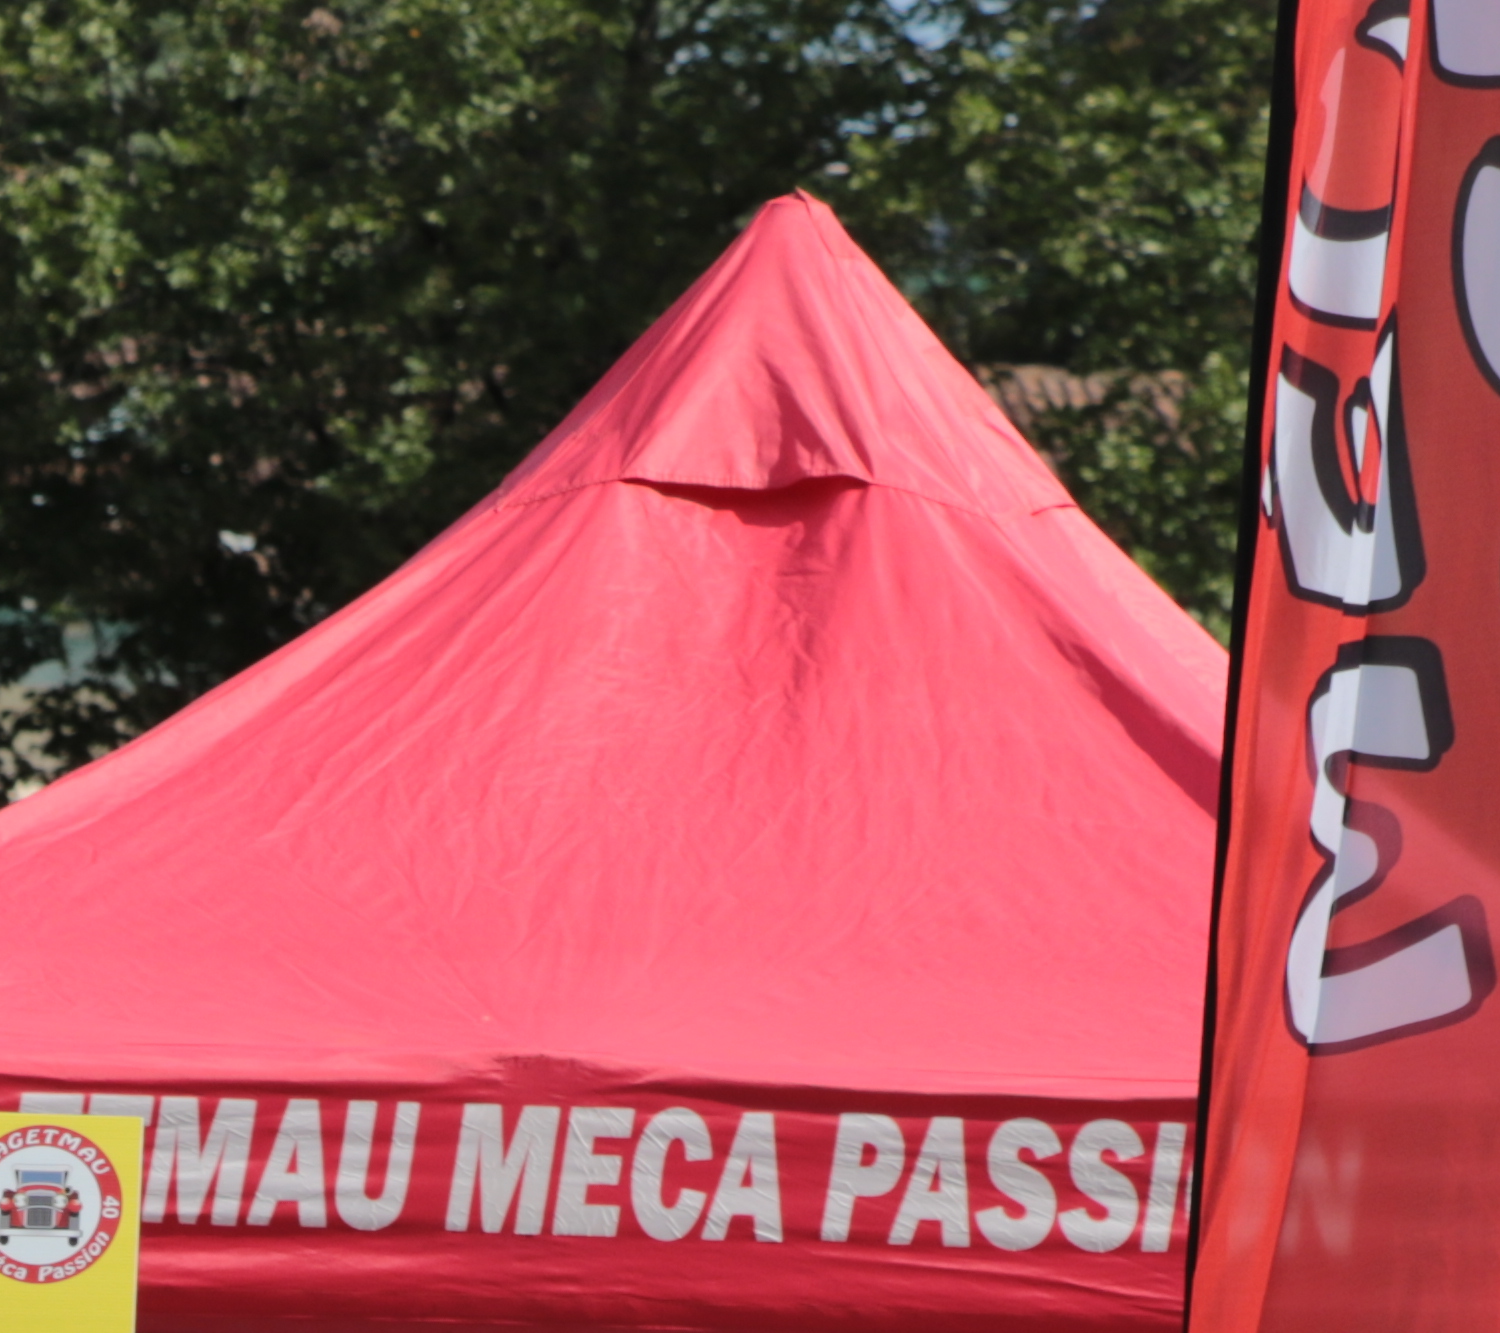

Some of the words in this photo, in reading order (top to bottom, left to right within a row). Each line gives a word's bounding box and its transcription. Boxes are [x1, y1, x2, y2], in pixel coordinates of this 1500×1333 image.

[444, 1101, 784, 1244] MECA
[101, 1195, 120, 1219] 40
[38, 1232, 110, 1282] Passion
